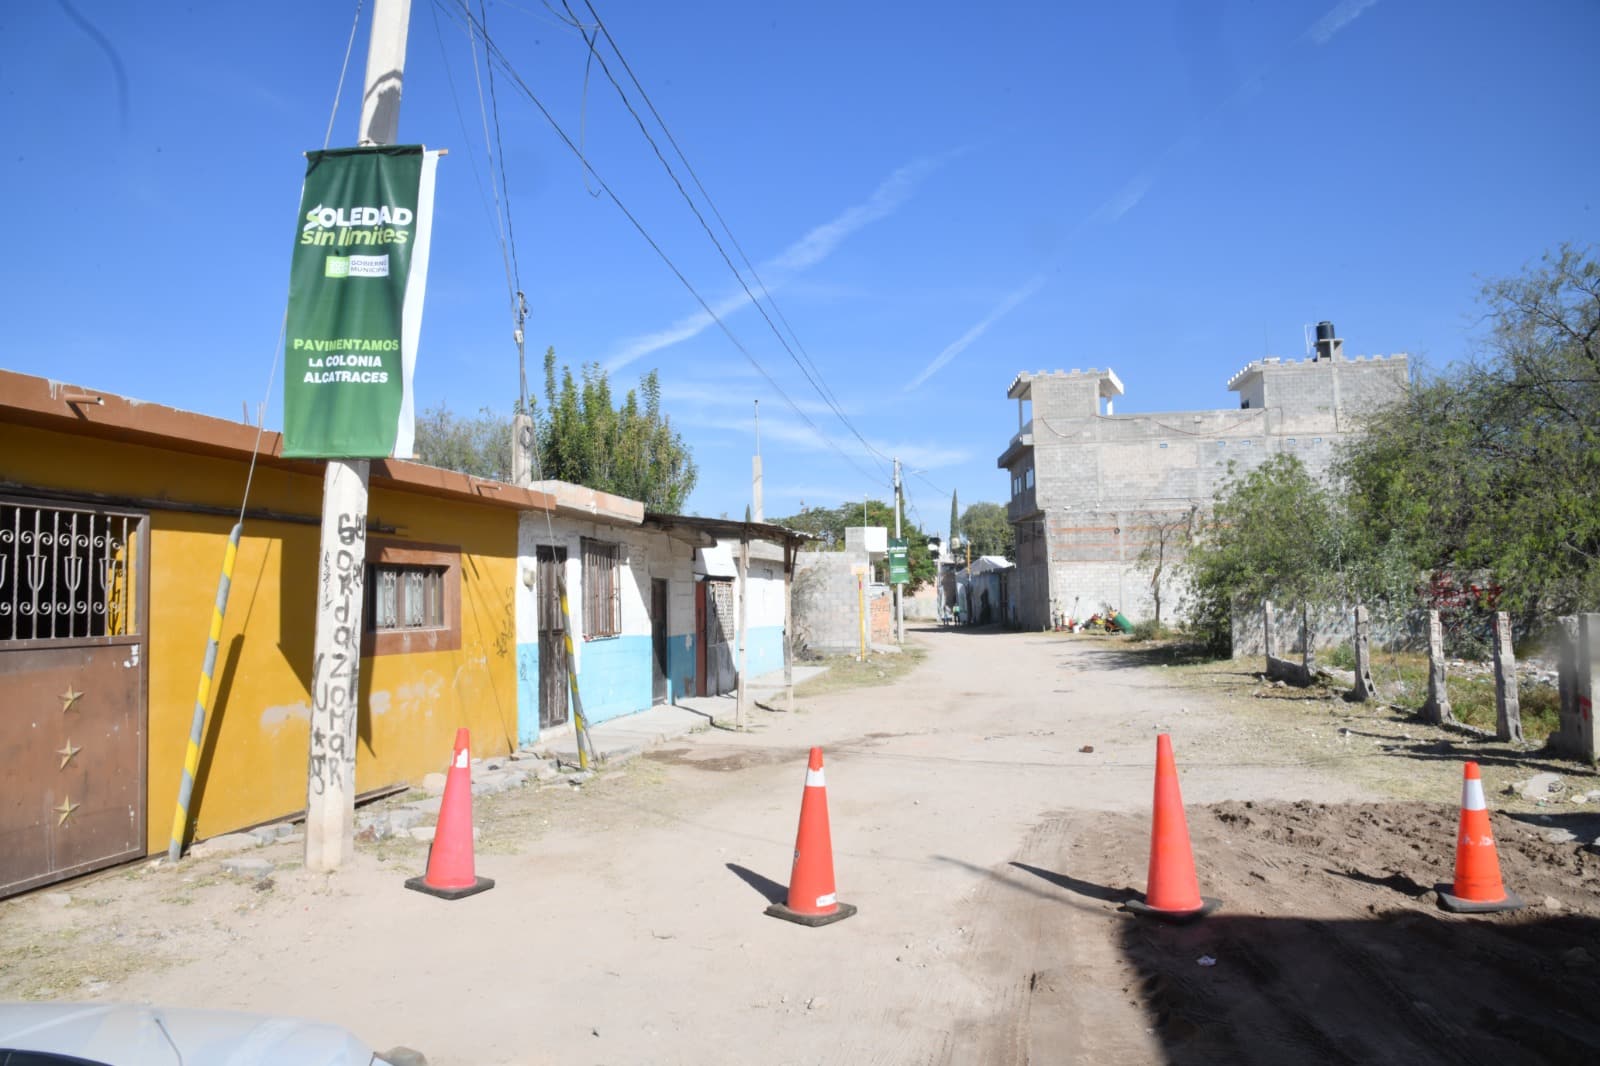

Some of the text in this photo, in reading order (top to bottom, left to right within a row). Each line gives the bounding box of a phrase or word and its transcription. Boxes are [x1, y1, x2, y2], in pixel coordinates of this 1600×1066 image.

[303, 203, 413, 231] SOLEDAD
[300, 227, 334, 245] sin
[293, 338, 399, 351] PAVIMENTAMOS
[308, 355, 382, 367] LA COLONIA
[303, 371, 388, 383] ALCATRACES
